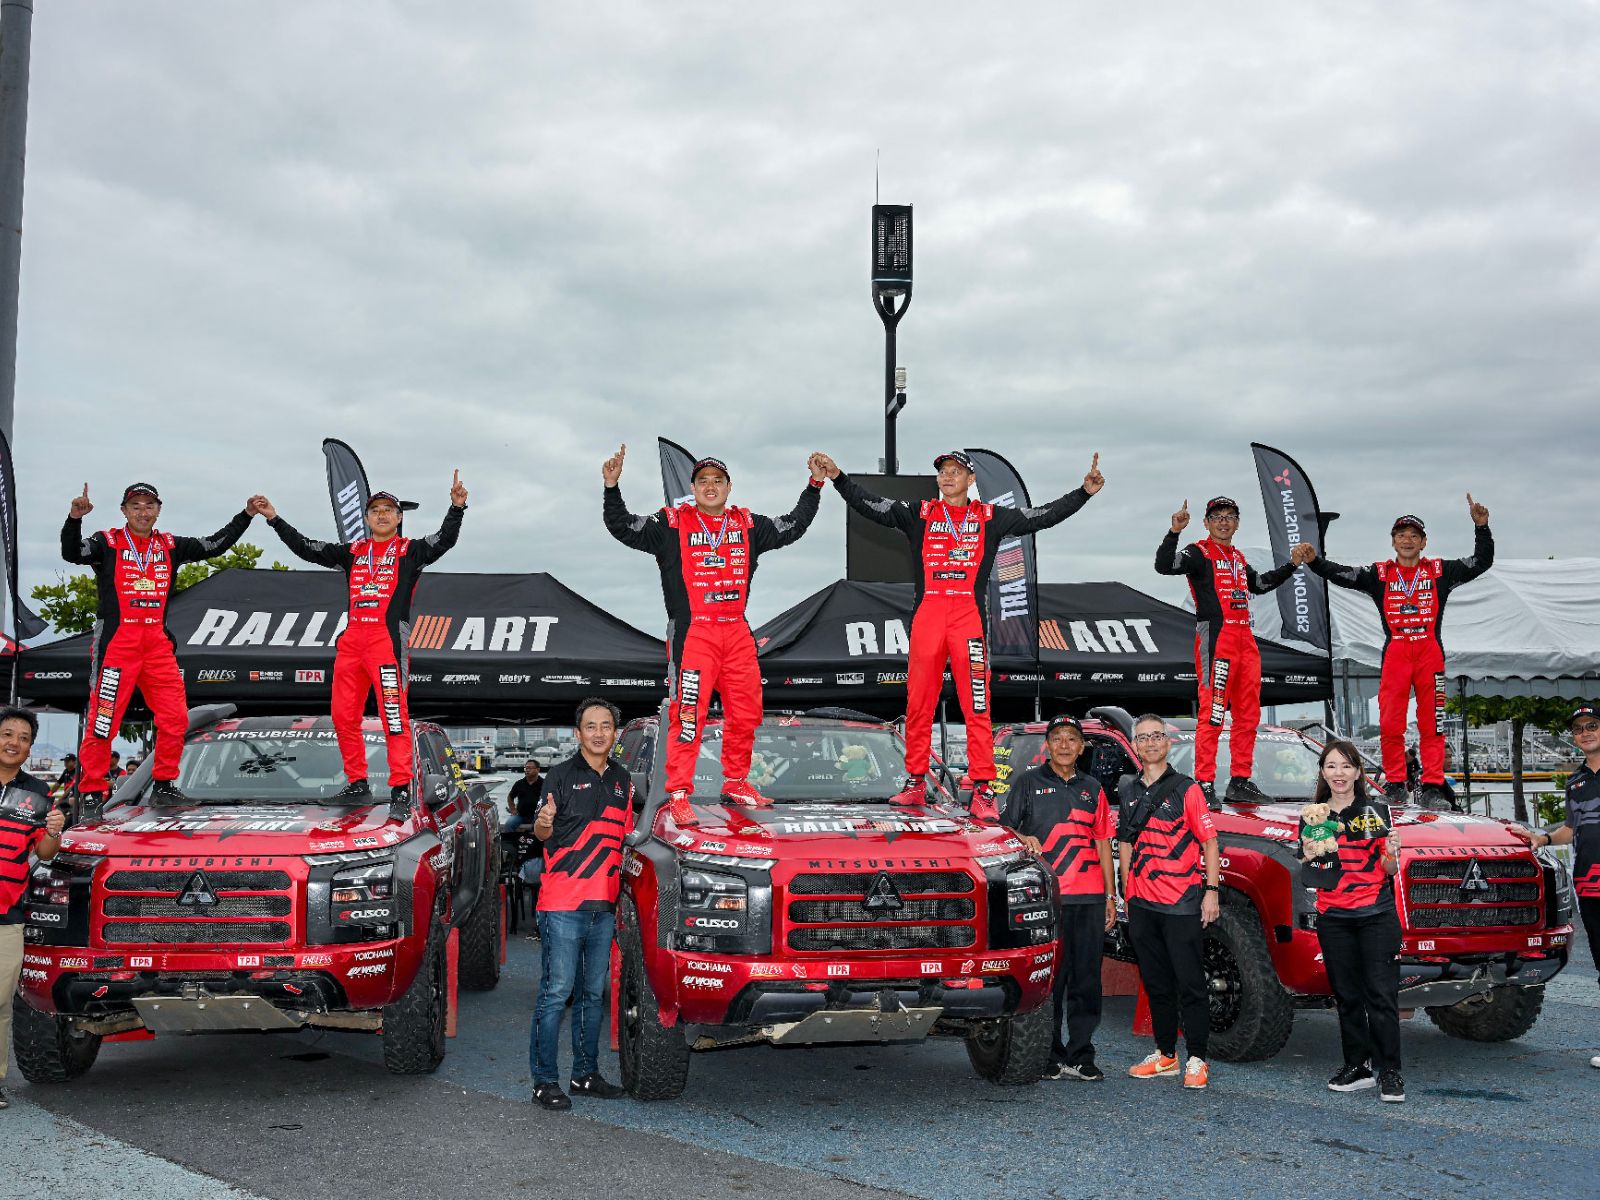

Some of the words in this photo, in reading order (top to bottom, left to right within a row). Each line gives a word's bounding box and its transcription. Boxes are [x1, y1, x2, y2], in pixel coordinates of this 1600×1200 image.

[451, 616, 558, 652] ART
[1068, 618, 1160, 653] ART
[34, 672, 73, 680] CUSCO
[197, 669, 237, 681] ENDLESS
[298, 671, 322, 682] TPR
[837, 673, 863, 682] HKS
[217, 731, 313, 740] MITSUBISHI
[1414, 847, 1517, 857] MITSUBISHI
[130, 857, 273, 867] MITSUBISHI
[809, 858, 952, 869] MITSUBISHI
[31, 912, 60, 921] CUSCO
[350, 908, 390, 919] CUSCO
[1023, 910, 1048, 922] CUSCO
[695, 918, 739, 929] CUSCO
[301, 954, 333, 965] ENDLESS
[354, 948, 394, 961] YOKOHAMA
[132, 958, 150, 967] TPR
[239, 957, 258, 966] TPR
[687, 960, 732, 972] YOKOHAMA
[361, 963, 387, 975] WORK
[750, 963, 784, 975] ENDLESS
[828, 965, 848, 975] TPR
[922, 963, 942, 973] TPR
[695, 976, 724, 988] WORK
